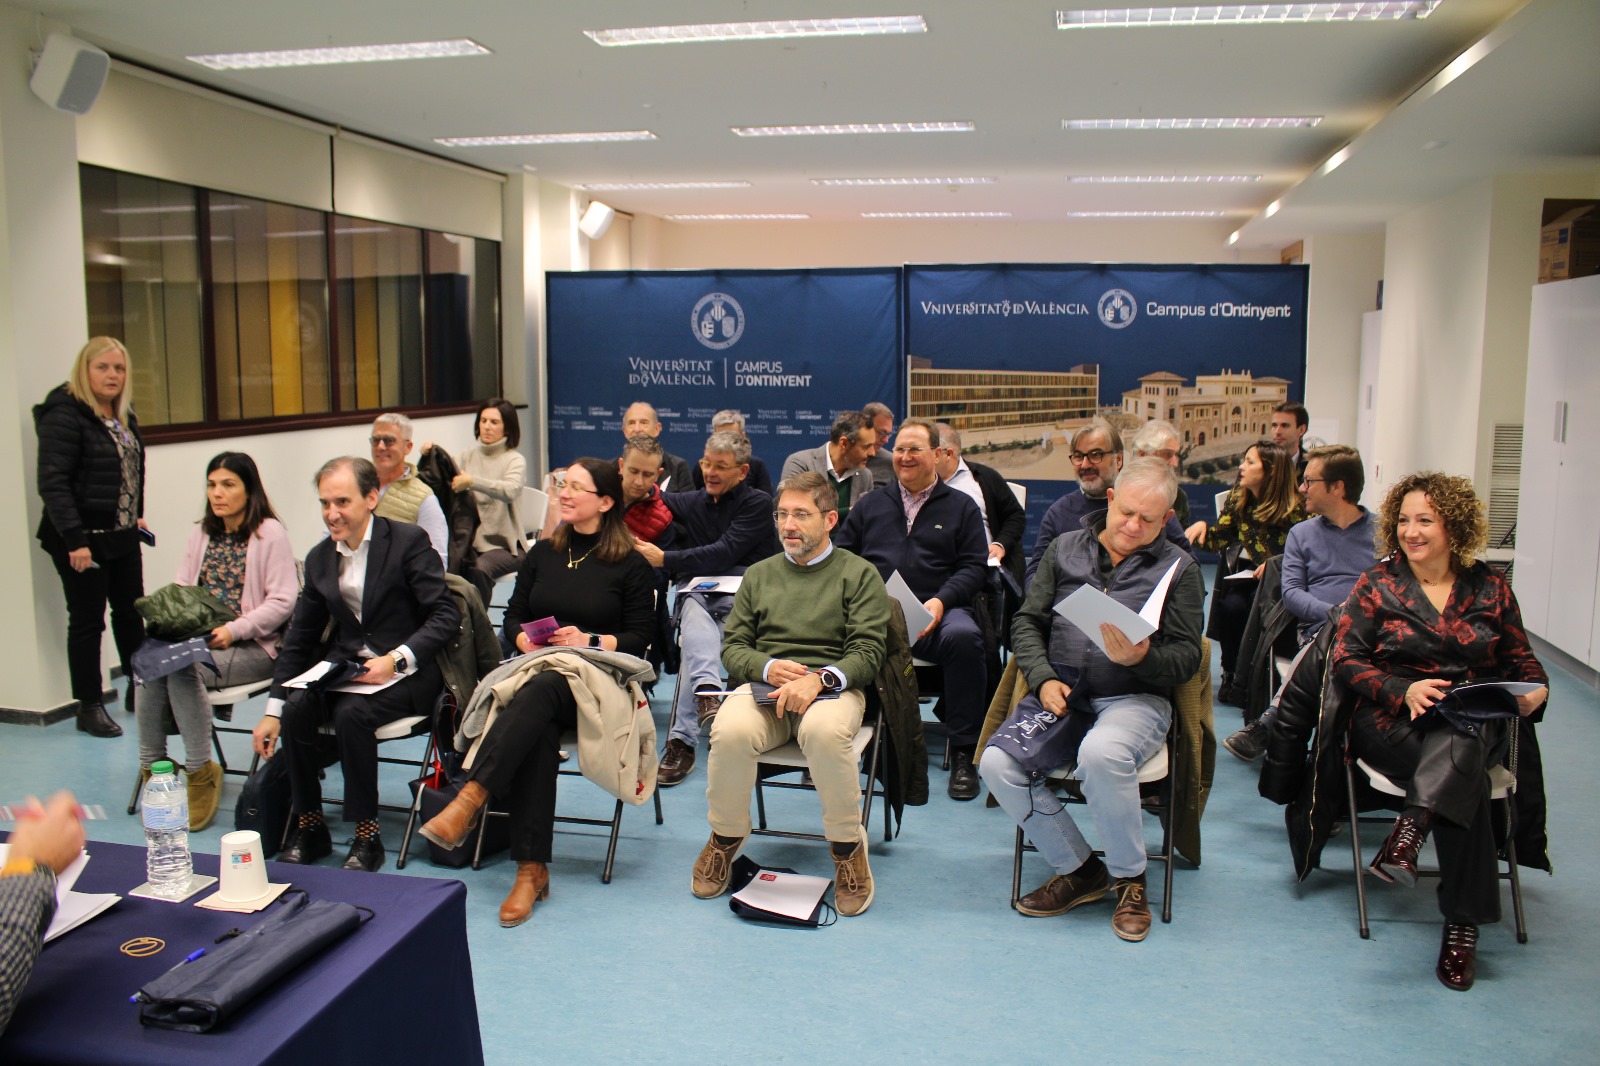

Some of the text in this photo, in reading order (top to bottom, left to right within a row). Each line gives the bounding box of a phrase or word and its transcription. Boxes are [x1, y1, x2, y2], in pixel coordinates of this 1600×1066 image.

[1146, 302, 1291, 321] Campus d'Ontinyent
[734, 360, 783, 373] CAMPUS
[735, 374, 812, 387] D'ONTINYENT
